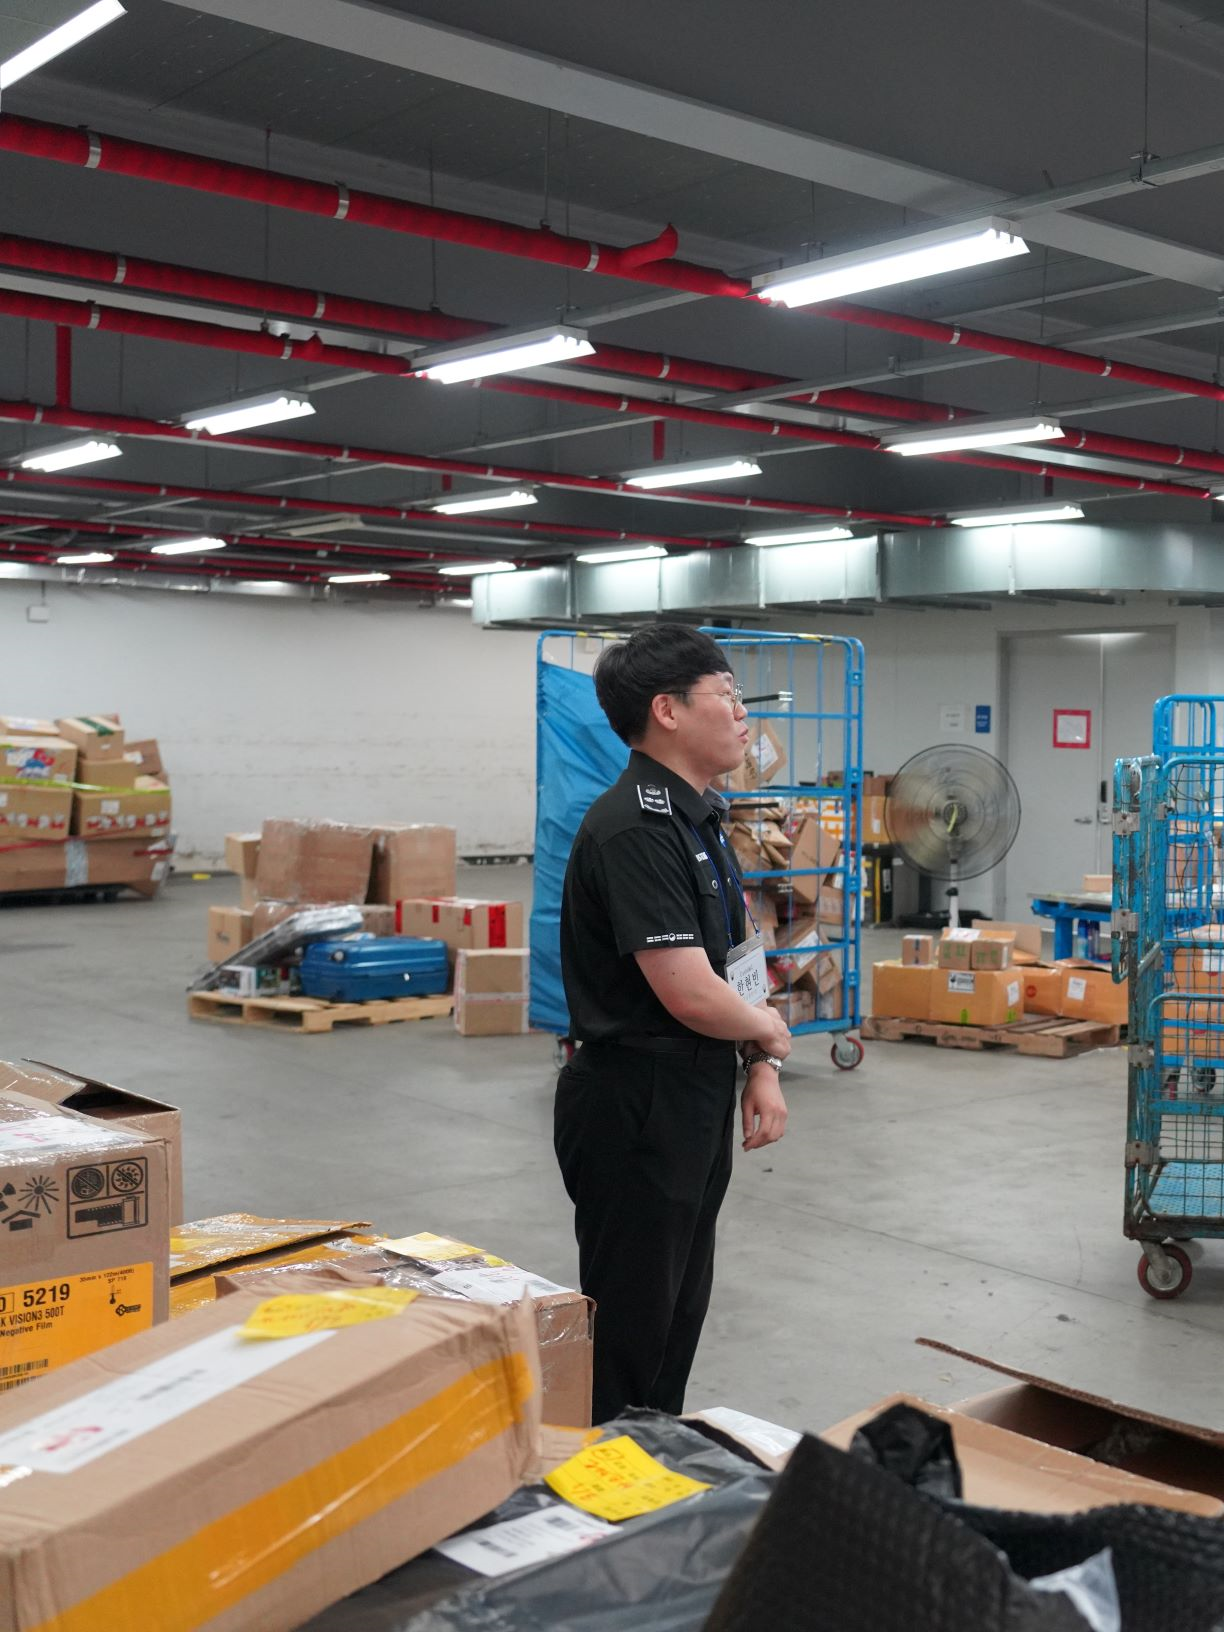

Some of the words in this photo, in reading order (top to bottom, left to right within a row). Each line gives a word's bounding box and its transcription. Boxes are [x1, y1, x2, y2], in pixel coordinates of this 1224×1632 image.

[737, 969, 760, 997] 한현빈
[23, 1283, 71, 1308] 5219
[9, 1310, 43, 1325] VISION3
[45, 1306, 65, 1318] 500T
[0, 1325, 34, 1337] Negative
[36, 1321, 53, 1331] Film
